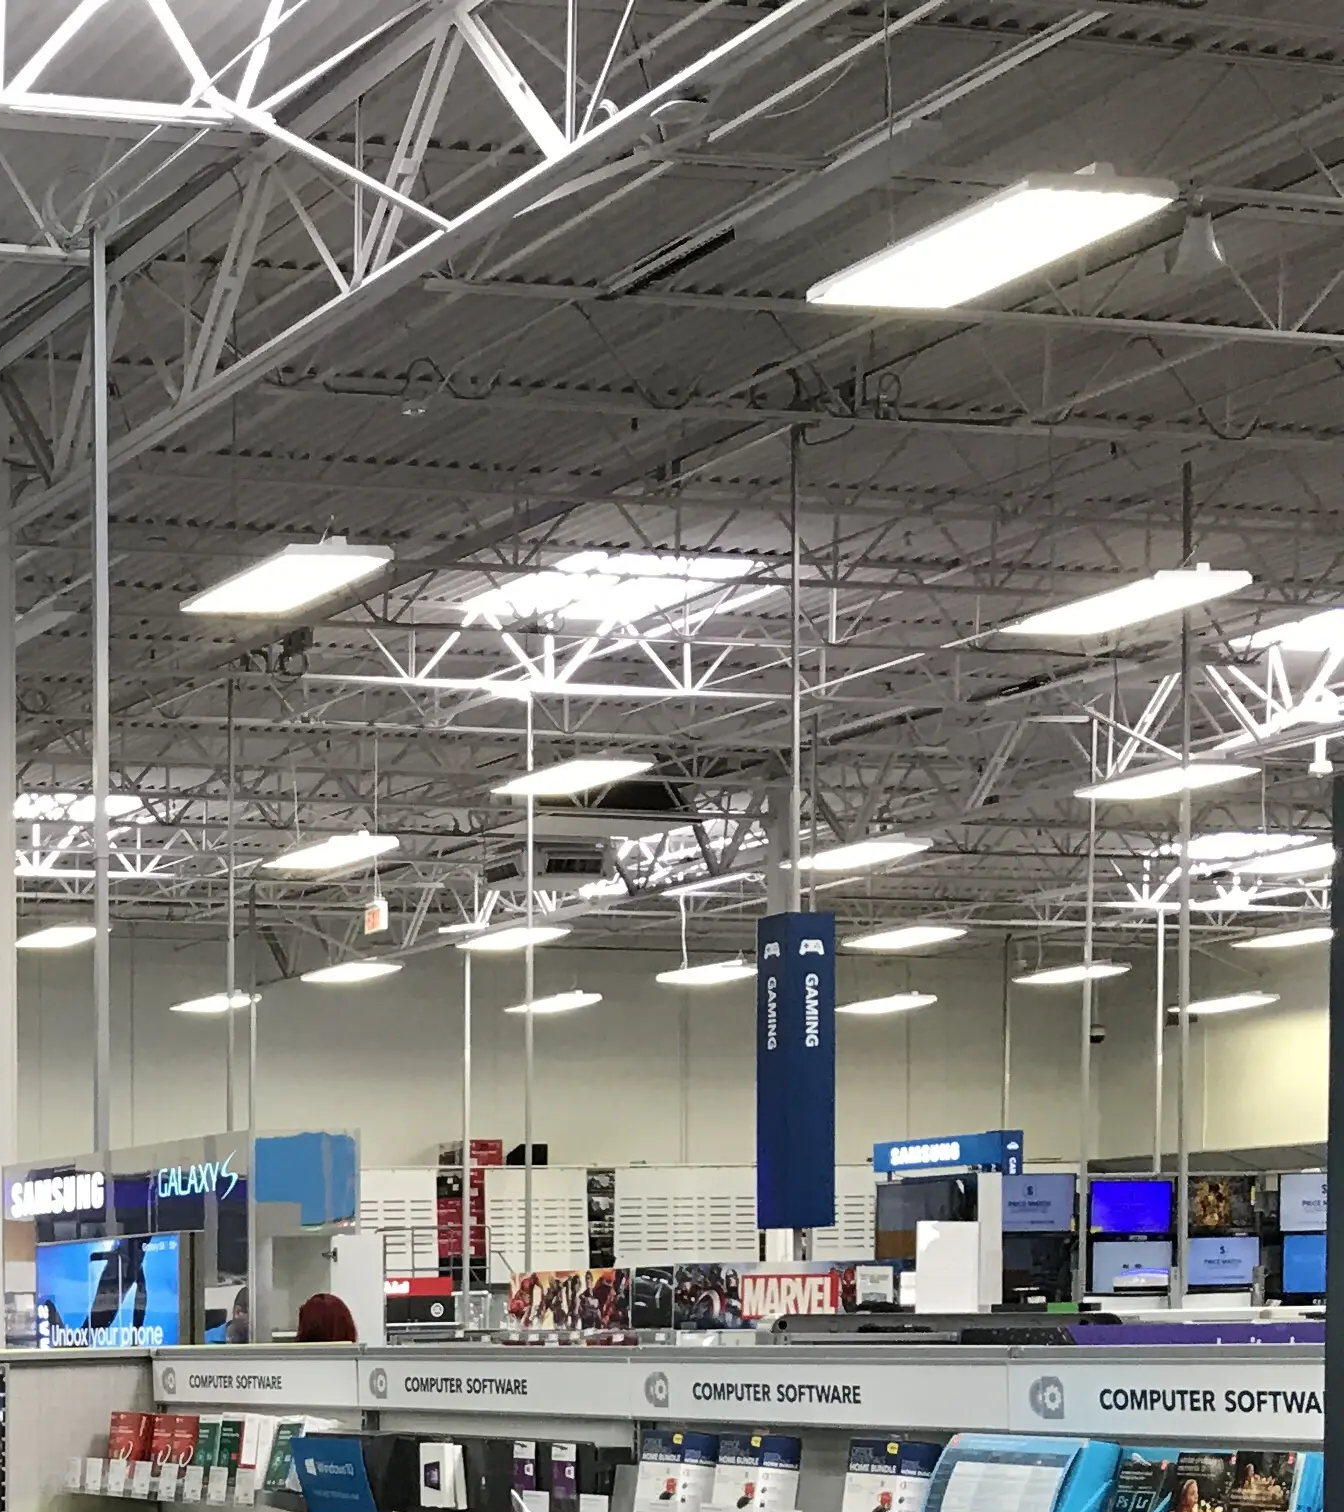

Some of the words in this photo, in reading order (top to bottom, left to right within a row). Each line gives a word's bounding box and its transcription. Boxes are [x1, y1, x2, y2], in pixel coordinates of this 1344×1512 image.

[766, 976, 778, 1051] GAMING
[804, 972, 819, 1048] GAMING
[890, 1141, 961, 1167] SAMSUNG
[157, 1162, 218, 1198] GALAXY
[220, 1150, 239, 1200] S
[10, 1171, 105, 1218] SAMSUNG
[743, 1276, 837, 1316] MARVEL
[51, 1324, 88, 1347] Unbox
[89, 1326, 119, 1348] your
[121, 1325, 163, 1348] phone
[188, 1373, 235, 1391] COMPUTER
[236, 1374, 282, 1390] SOFTWARE
[404, 1376, 462, 1394] COMPUTER
[466, 1377, 528, 1396] SOFTWARE
[692, 1381, 770, 1402] COMPUTER
[777, 1385, 861, 1404] SOFTWARE
[1099, 1388, 1216, 1412] COMPUTER
[1225, 1389, 1325, 1415] SOFTWA
[849, 1462, 869, 1472] HOME
[871, 1464, 897, 1474] BUNDLE
